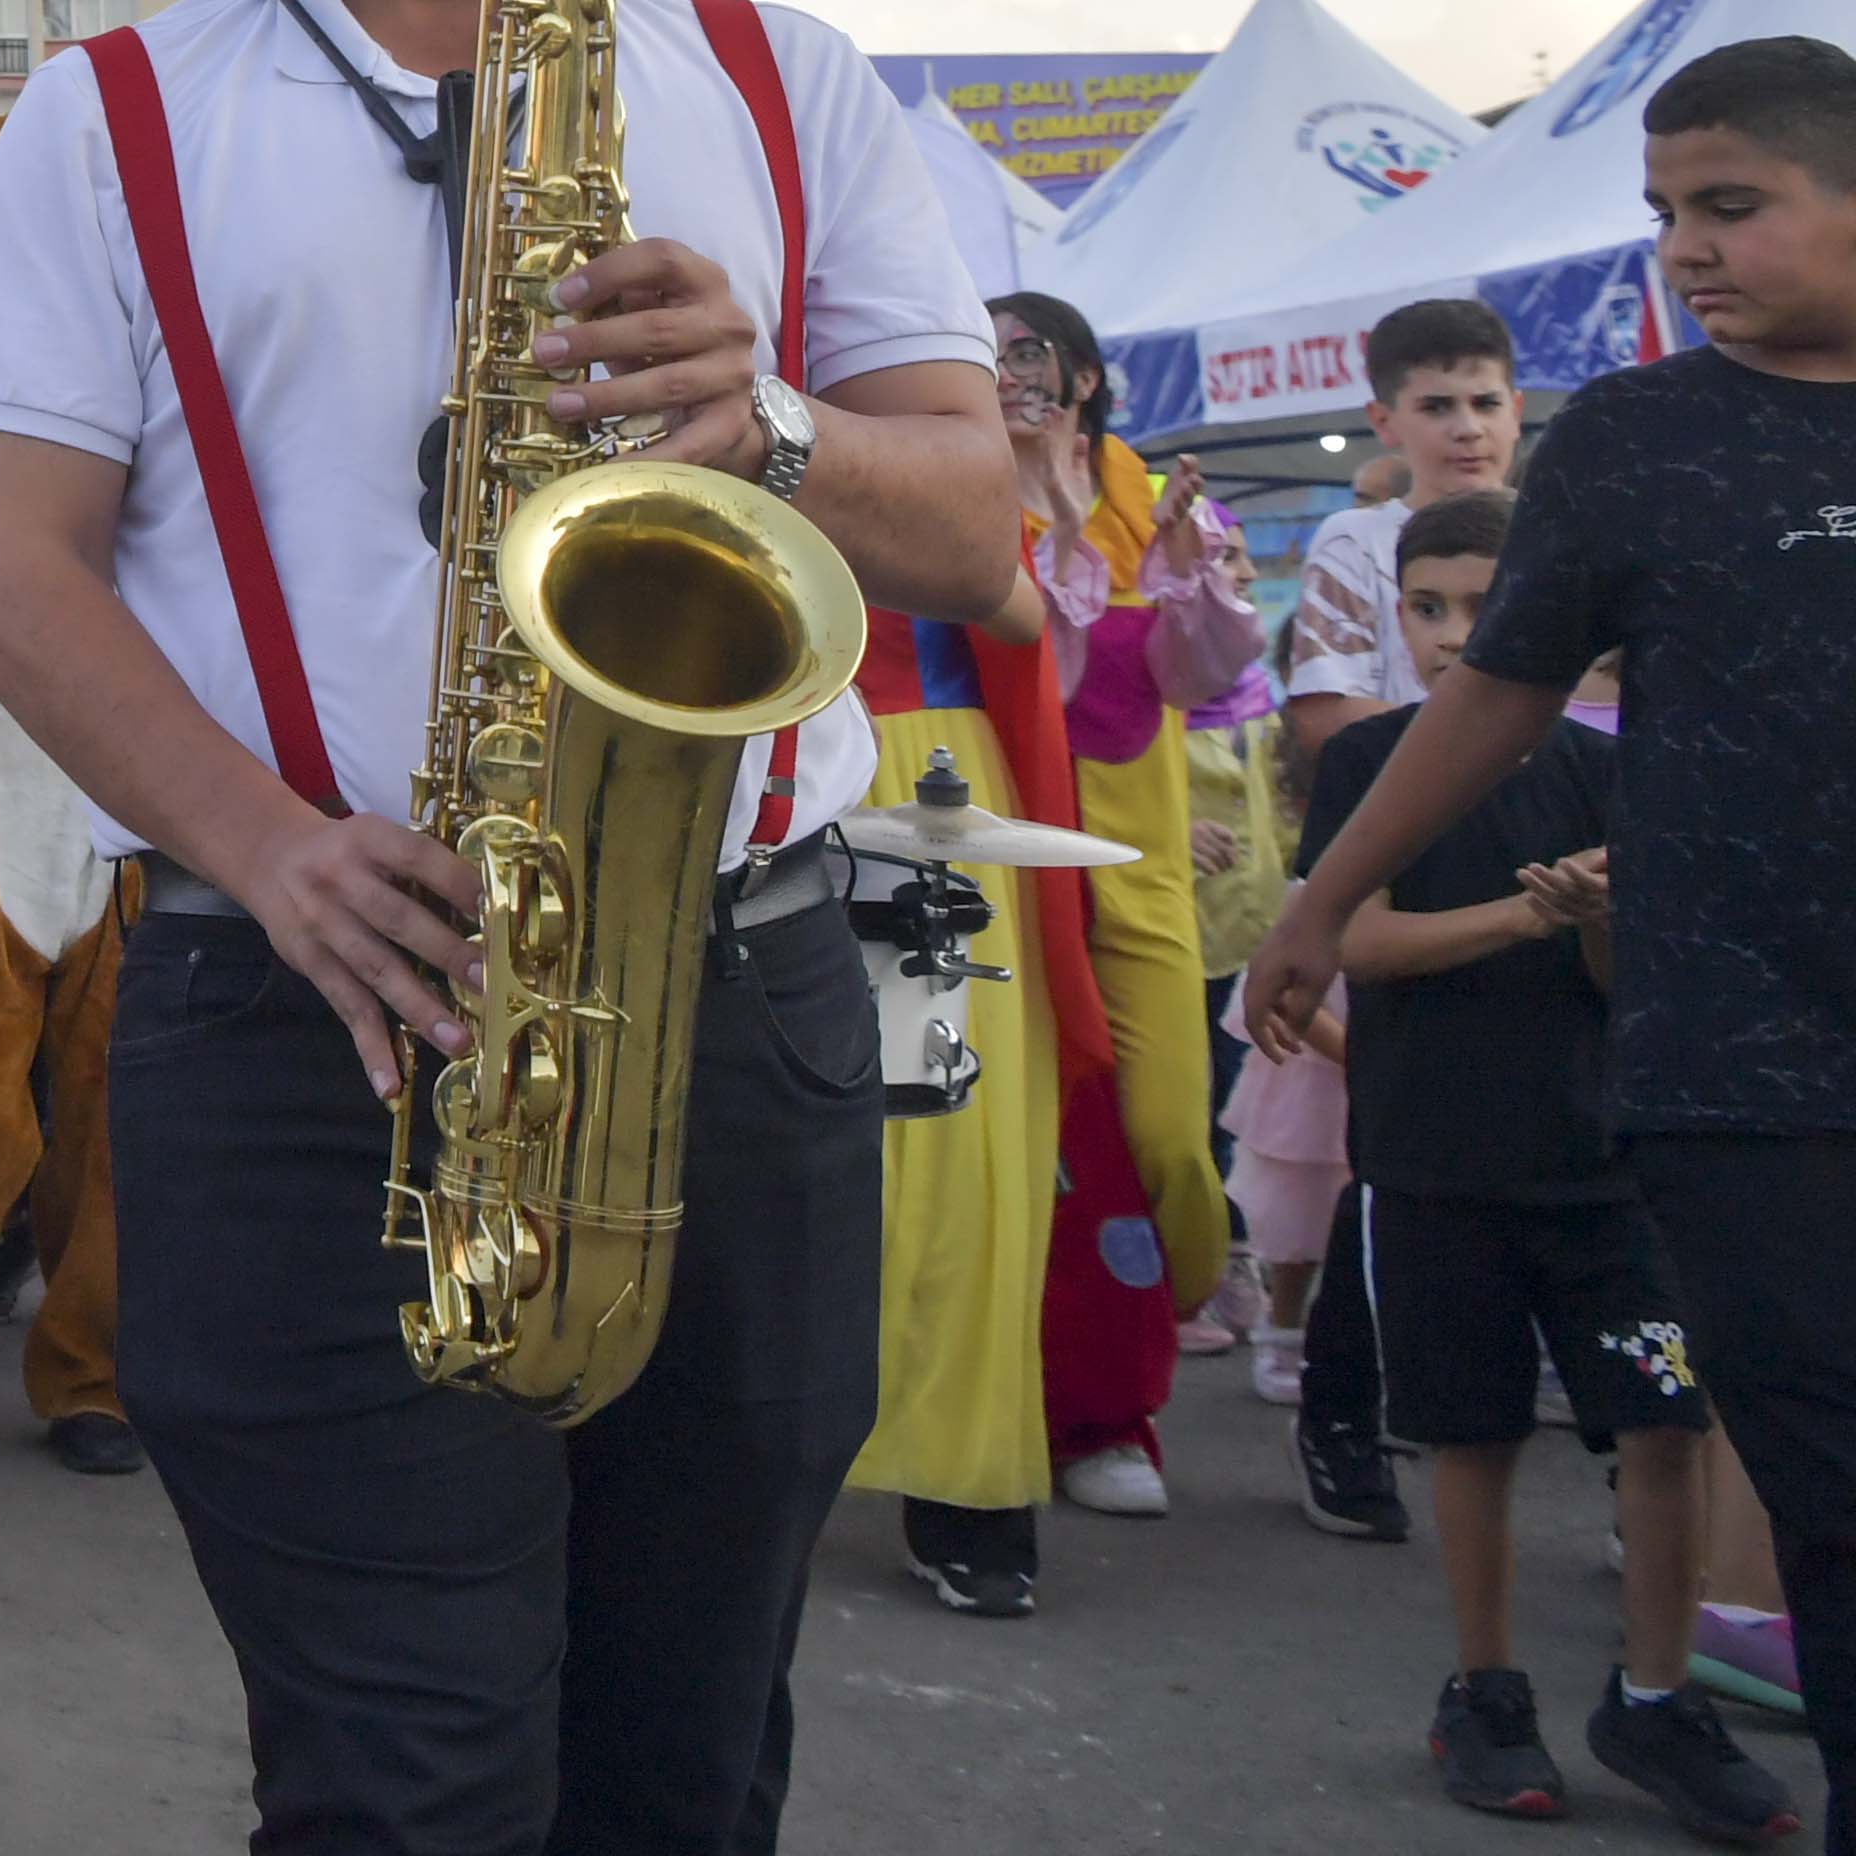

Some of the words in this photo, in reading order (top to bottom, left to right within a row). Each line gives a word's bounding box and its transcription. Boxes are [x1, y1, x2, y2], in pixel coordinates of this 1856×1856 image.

[947, 83, 1002, 110] HER
[1208, 345, 1280, 404] SIFIR
[1286, 335, 1353, 393] ATIK
